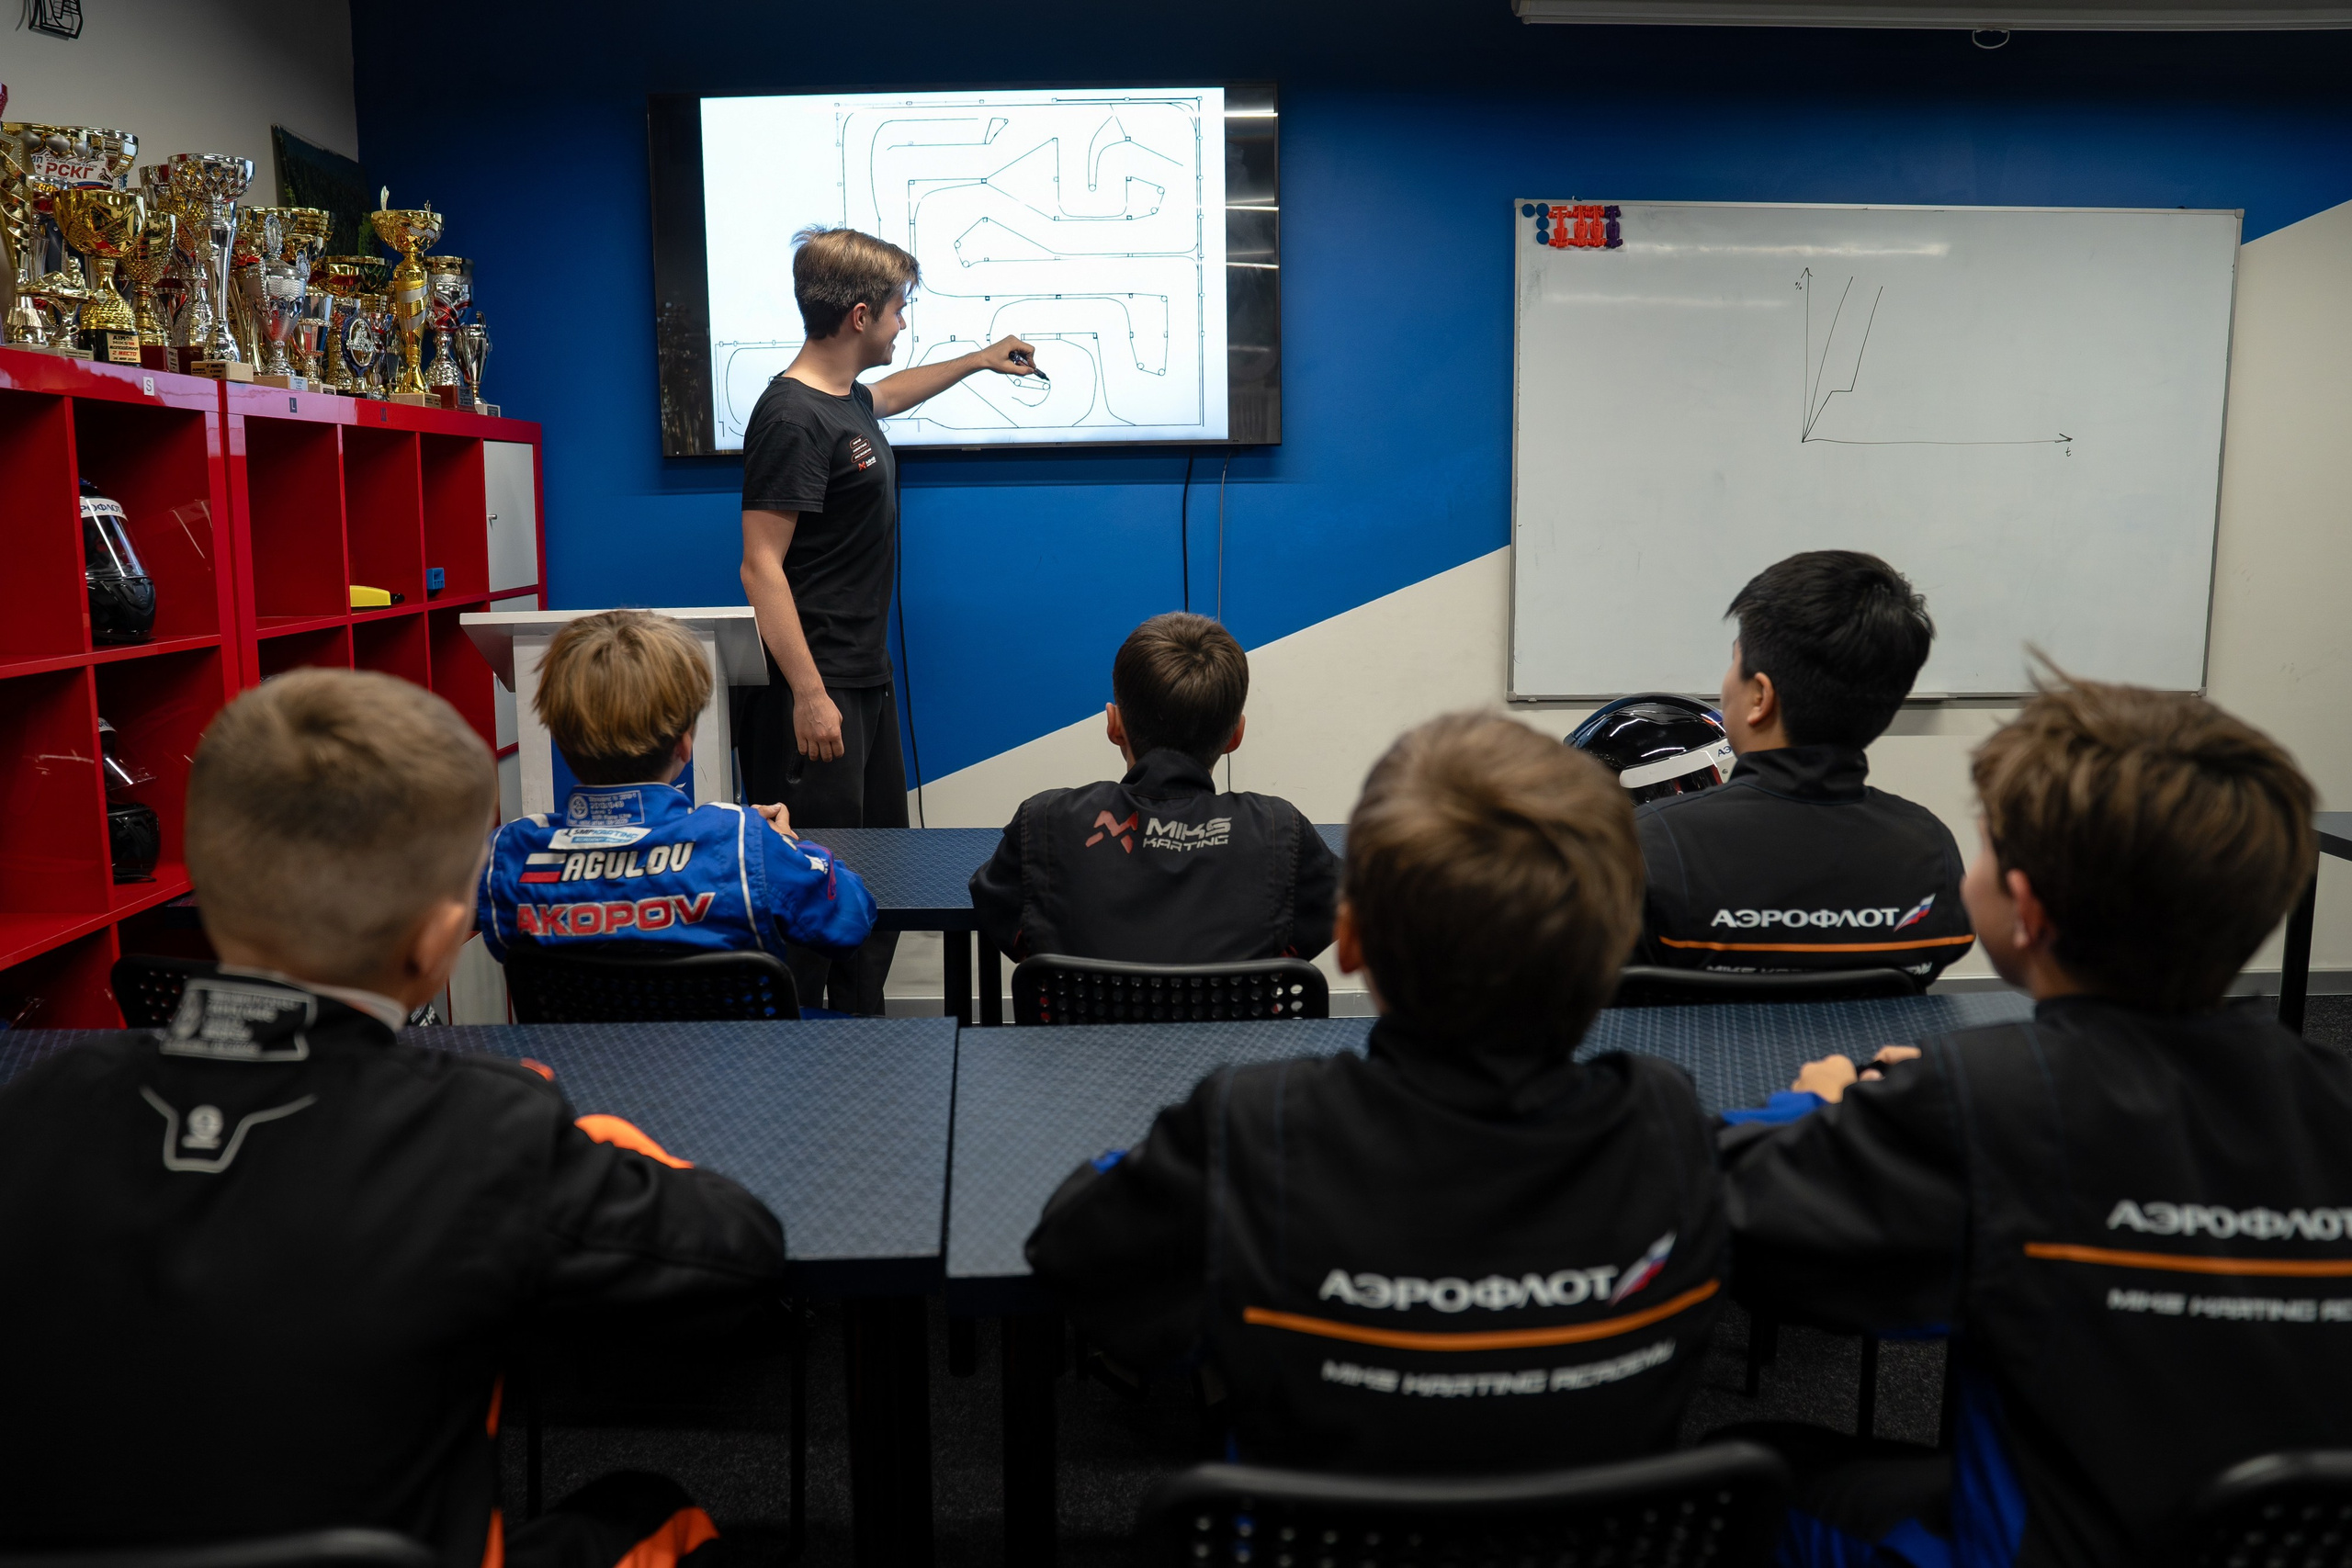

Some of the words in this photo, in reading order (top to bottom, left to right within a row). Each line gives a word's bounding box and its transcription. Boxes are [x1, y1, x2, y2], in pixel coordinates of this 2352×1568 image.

[45, 162, 94, 179] РСКГ
[145, 379, 153, 392] S
[2065, 446, 2072, 457] t
[80, 503, 121, 513] РОФЛОТ
[1145, 817, 1232, 840] MIKS
[1143, 834, 1229, 852] KARTING
[560, 842, 695, 882] AGULOV
[517, 891, 716, 937] AKOPOV
[1710, 908, 1900, 929] АЭРОФЛОТ
[1319, 1265, 1618, 1314] АЭРОФЛОТ
